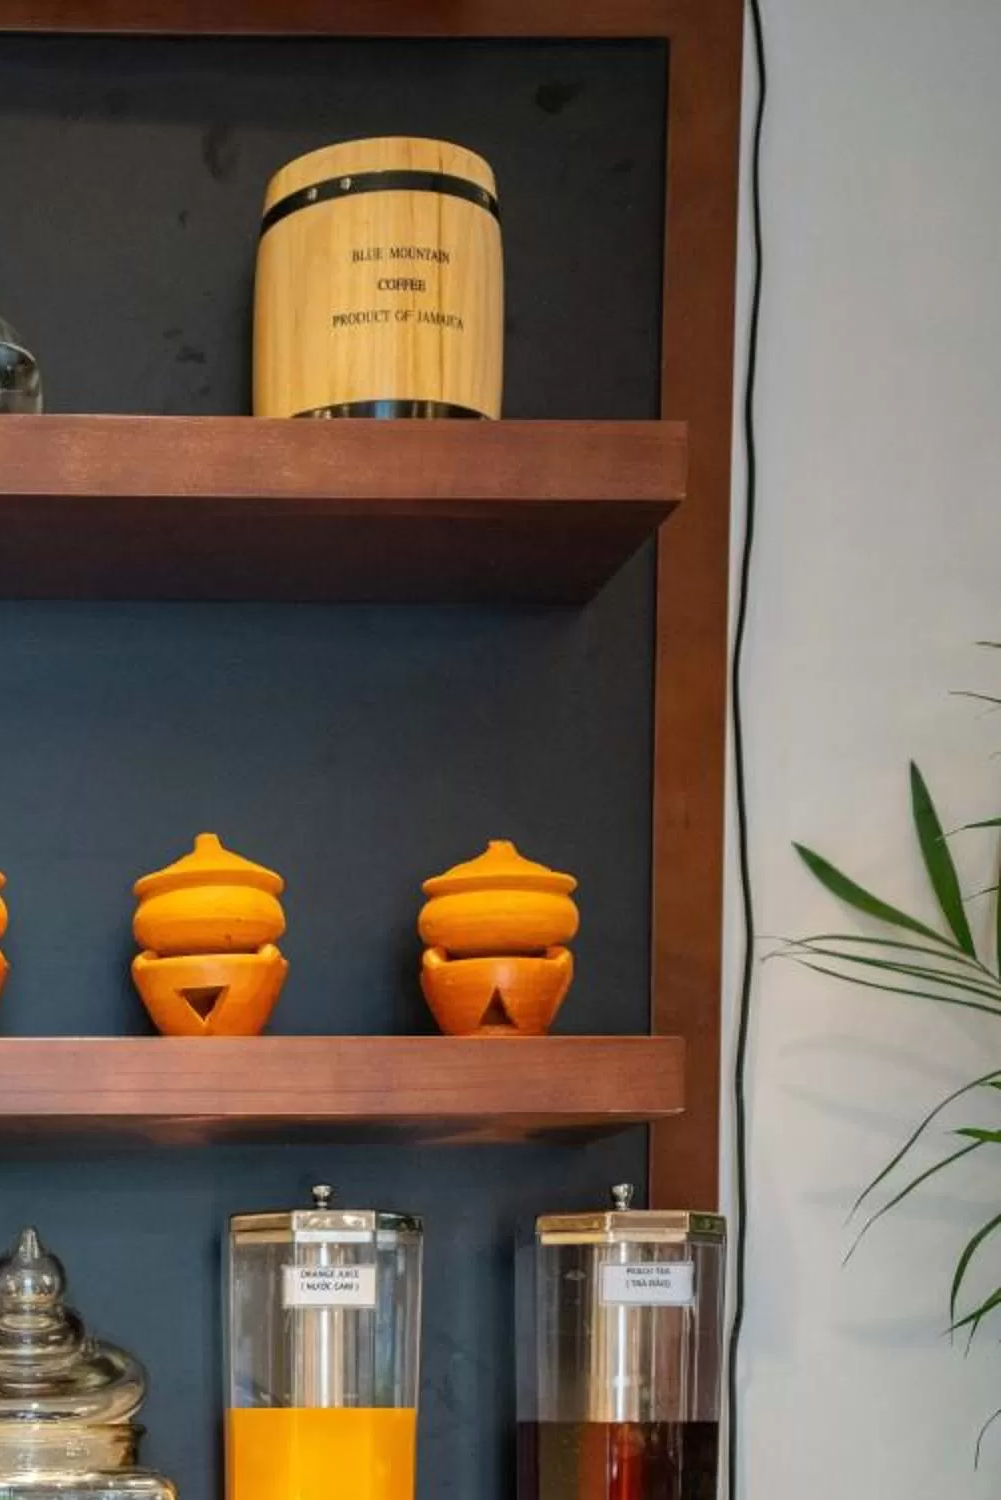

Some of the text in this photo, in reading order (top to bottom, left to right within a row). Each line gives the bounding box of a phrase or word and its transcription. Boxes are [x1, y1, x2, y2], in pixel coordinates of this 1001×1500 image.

[352, 246, 450, 265] BLUE MOUNTAIN
[377, 277, 426, 292] COFFEE
[332, 308, 464, 331] PRODUCT OF JAMAICA
